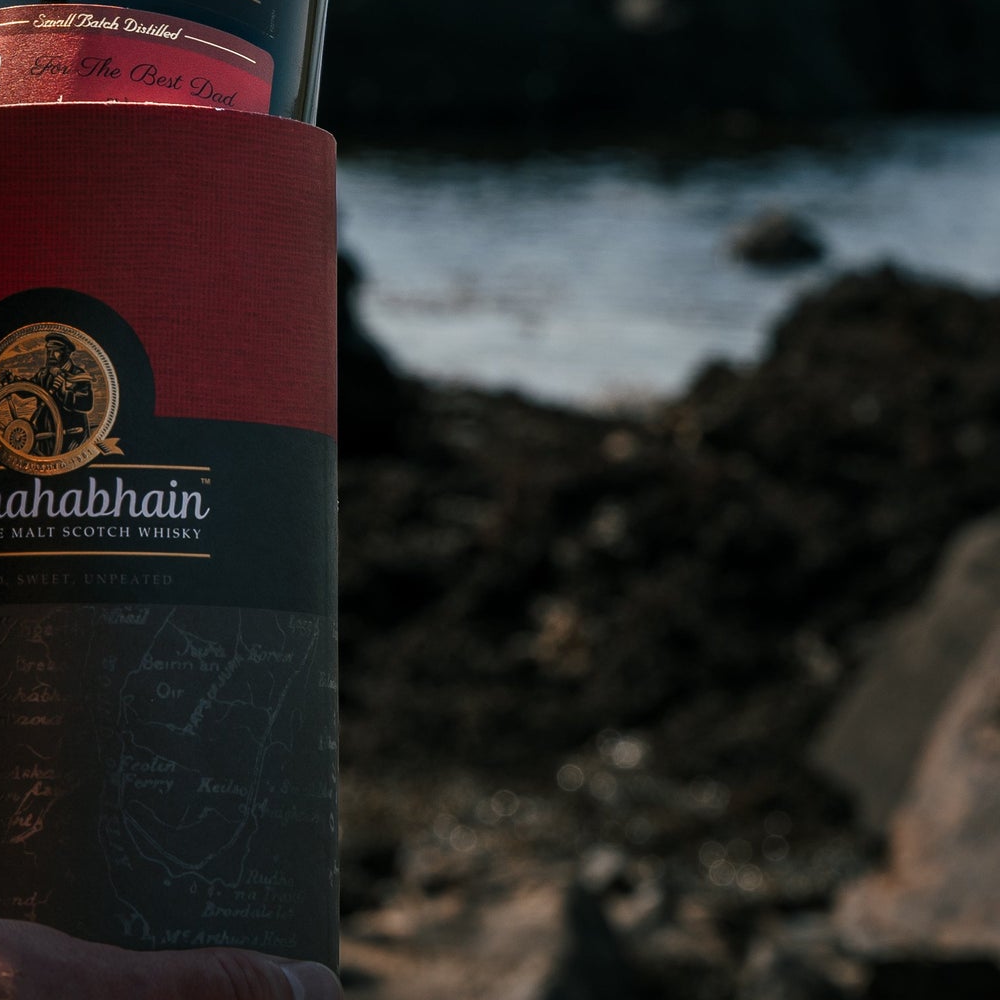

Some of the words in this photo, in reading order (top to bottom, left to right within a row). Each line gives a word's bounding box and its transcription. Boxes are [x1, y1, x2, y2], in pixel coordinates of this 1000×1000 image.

[32, 13, 76, 28] Small
[77, 14, 119, 30] Batch
[123, 20, 181, 40] Distilled
[29, 54, 70, 76] For
[76, 57, 122, 79] The
[130, 63, 182, 90] Best
[190, 77, 239, 107] Dad
[11, 526, 55, 539] MALT
[63, 526, 130, 538] SCOTCH
[138, 527, 201, 540] WHISKY
[84, 573, 173, 586] UNPEATED
